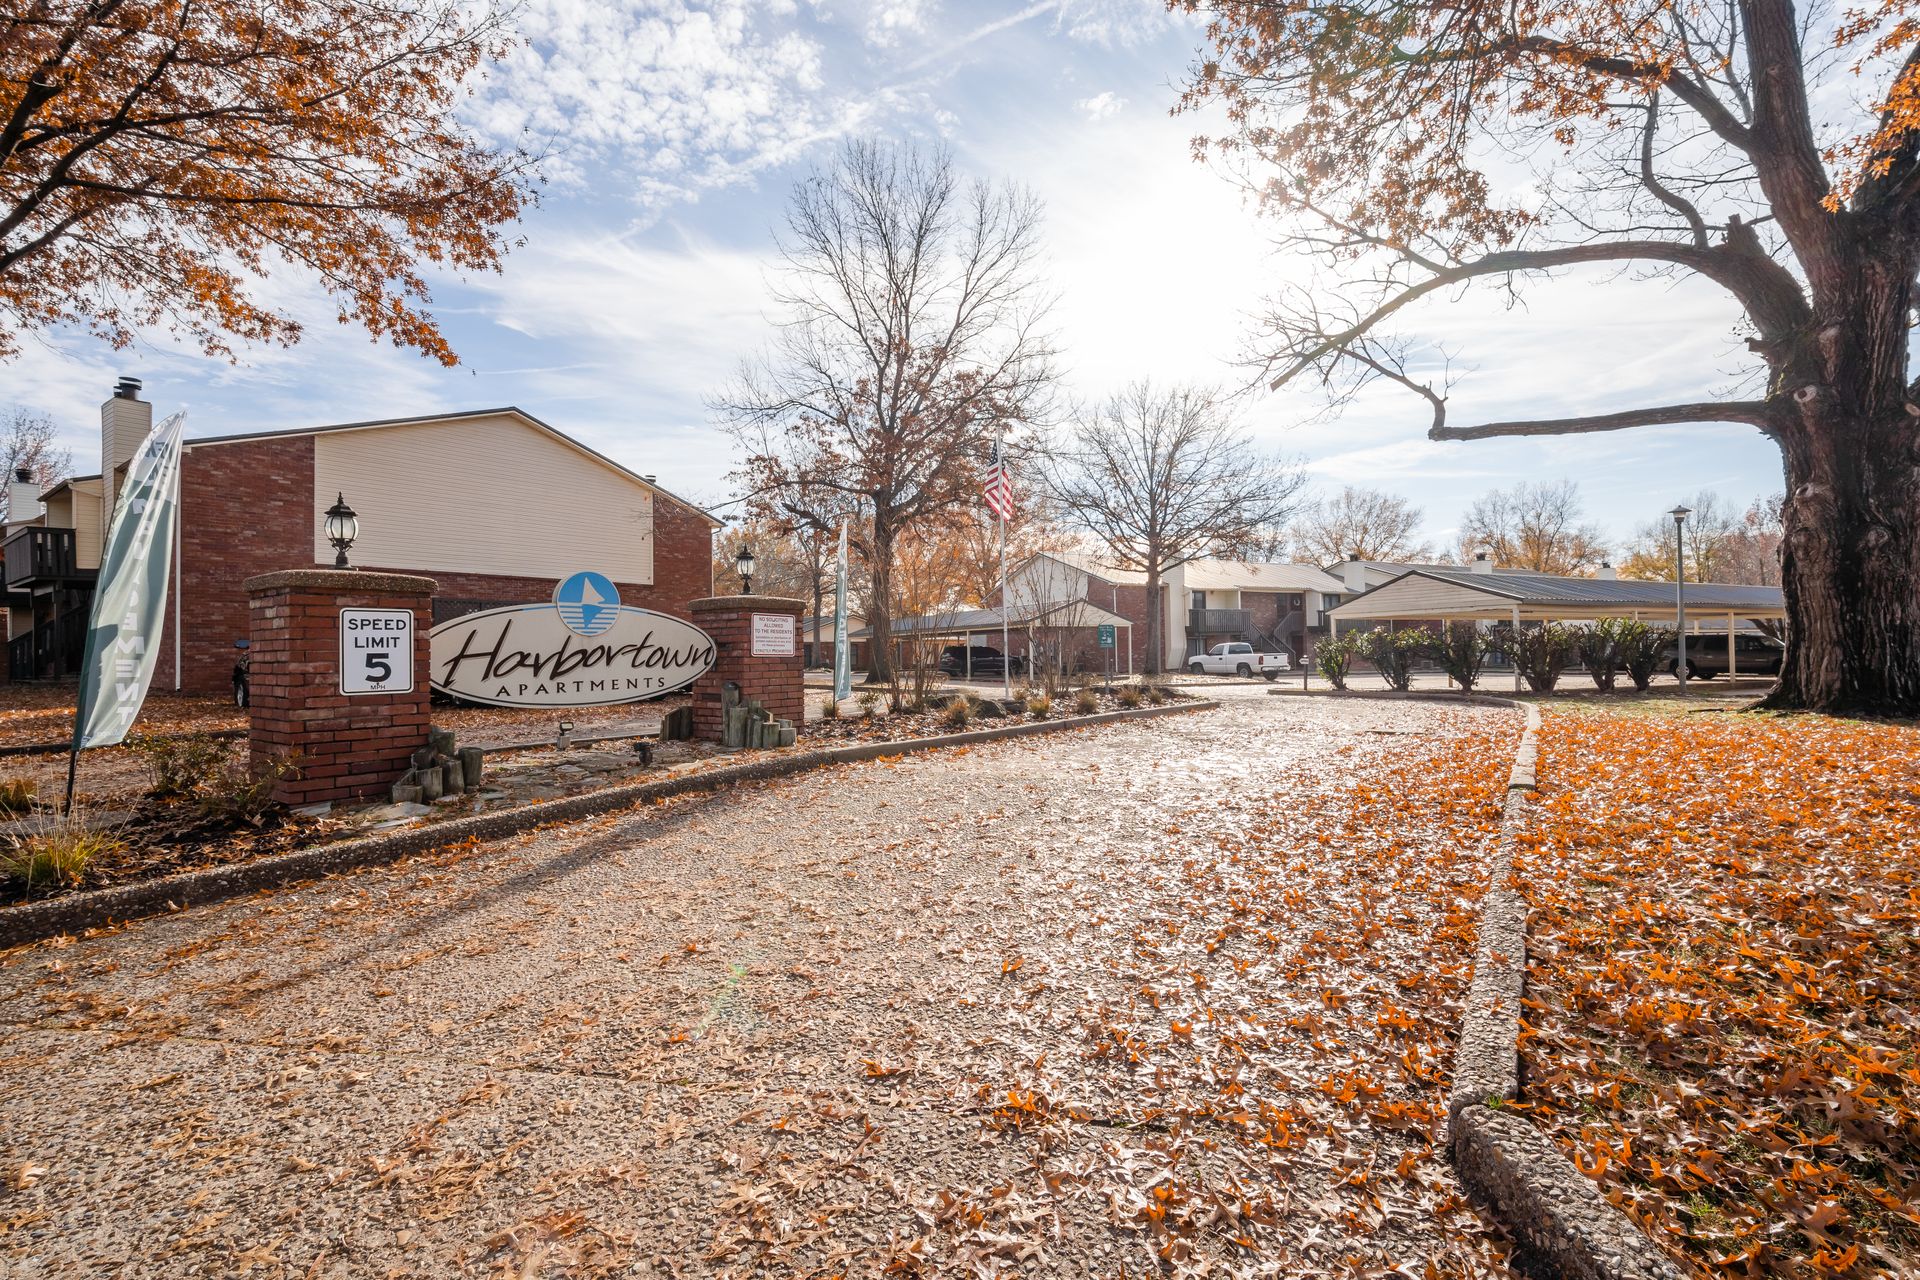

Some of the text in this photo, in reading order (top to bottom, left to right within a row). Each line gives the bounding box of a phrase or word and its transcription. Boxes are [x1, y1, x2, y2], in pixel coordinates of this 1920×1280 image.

[348, 618, 406, 630] SPEED
[354, 637, 400, 648] LIMIT
[442, 619, 713, 688] Harbortown
[365, 653, 391, 682] 5
[495, 677, 666, 697] APARTMENTS
